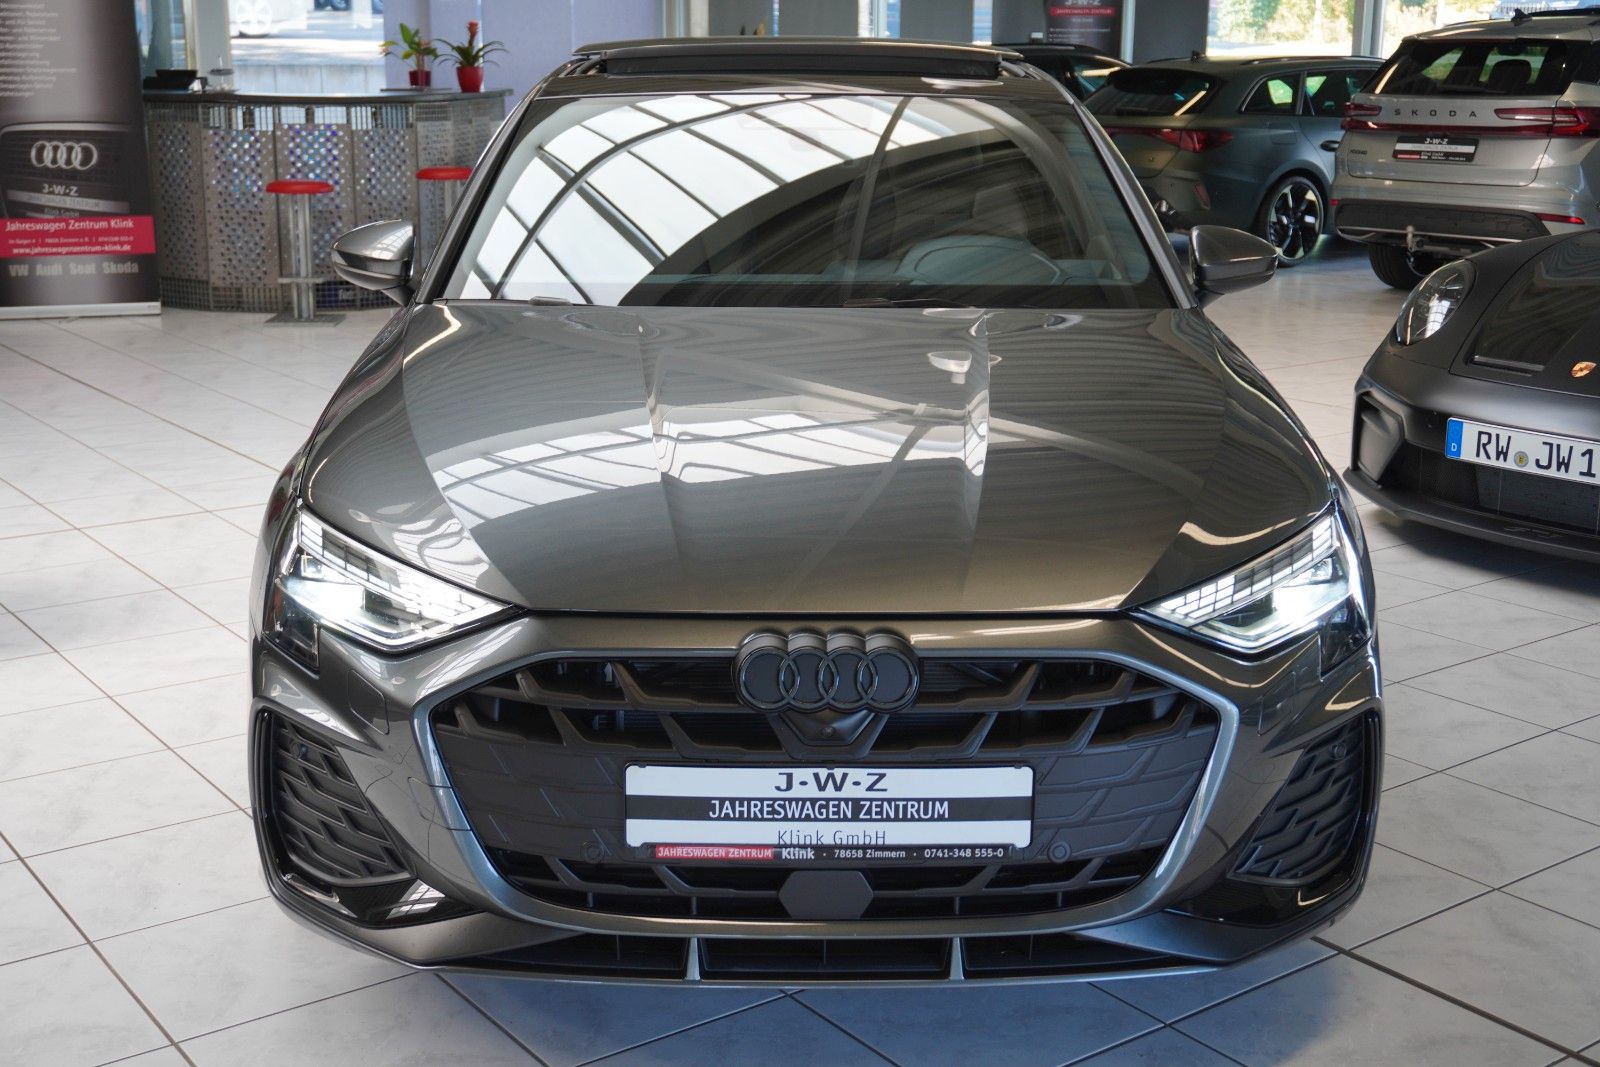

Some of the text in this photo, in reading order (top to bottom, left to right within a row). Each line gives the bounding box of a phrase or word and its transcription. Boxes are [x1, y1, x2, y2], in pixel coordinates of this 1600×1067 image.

[6, 218, 135, 232] Jahreswagen Zentrum Klink
[8, 261, 139, 277] VW Audi Seat Skoda
[1451, 442, 1458, 452] D
[1475, 430, 1512, 463] RW
[708, 800, 950, 819] JAHRESWAGEN ZENTRUM
[777, 829, 886, 845] Klink GmbH
[658, 847, 1004, 860] JAHRESWAGEN ZENTRUM Klink 78658 Zimmern 0741-348 555-0
